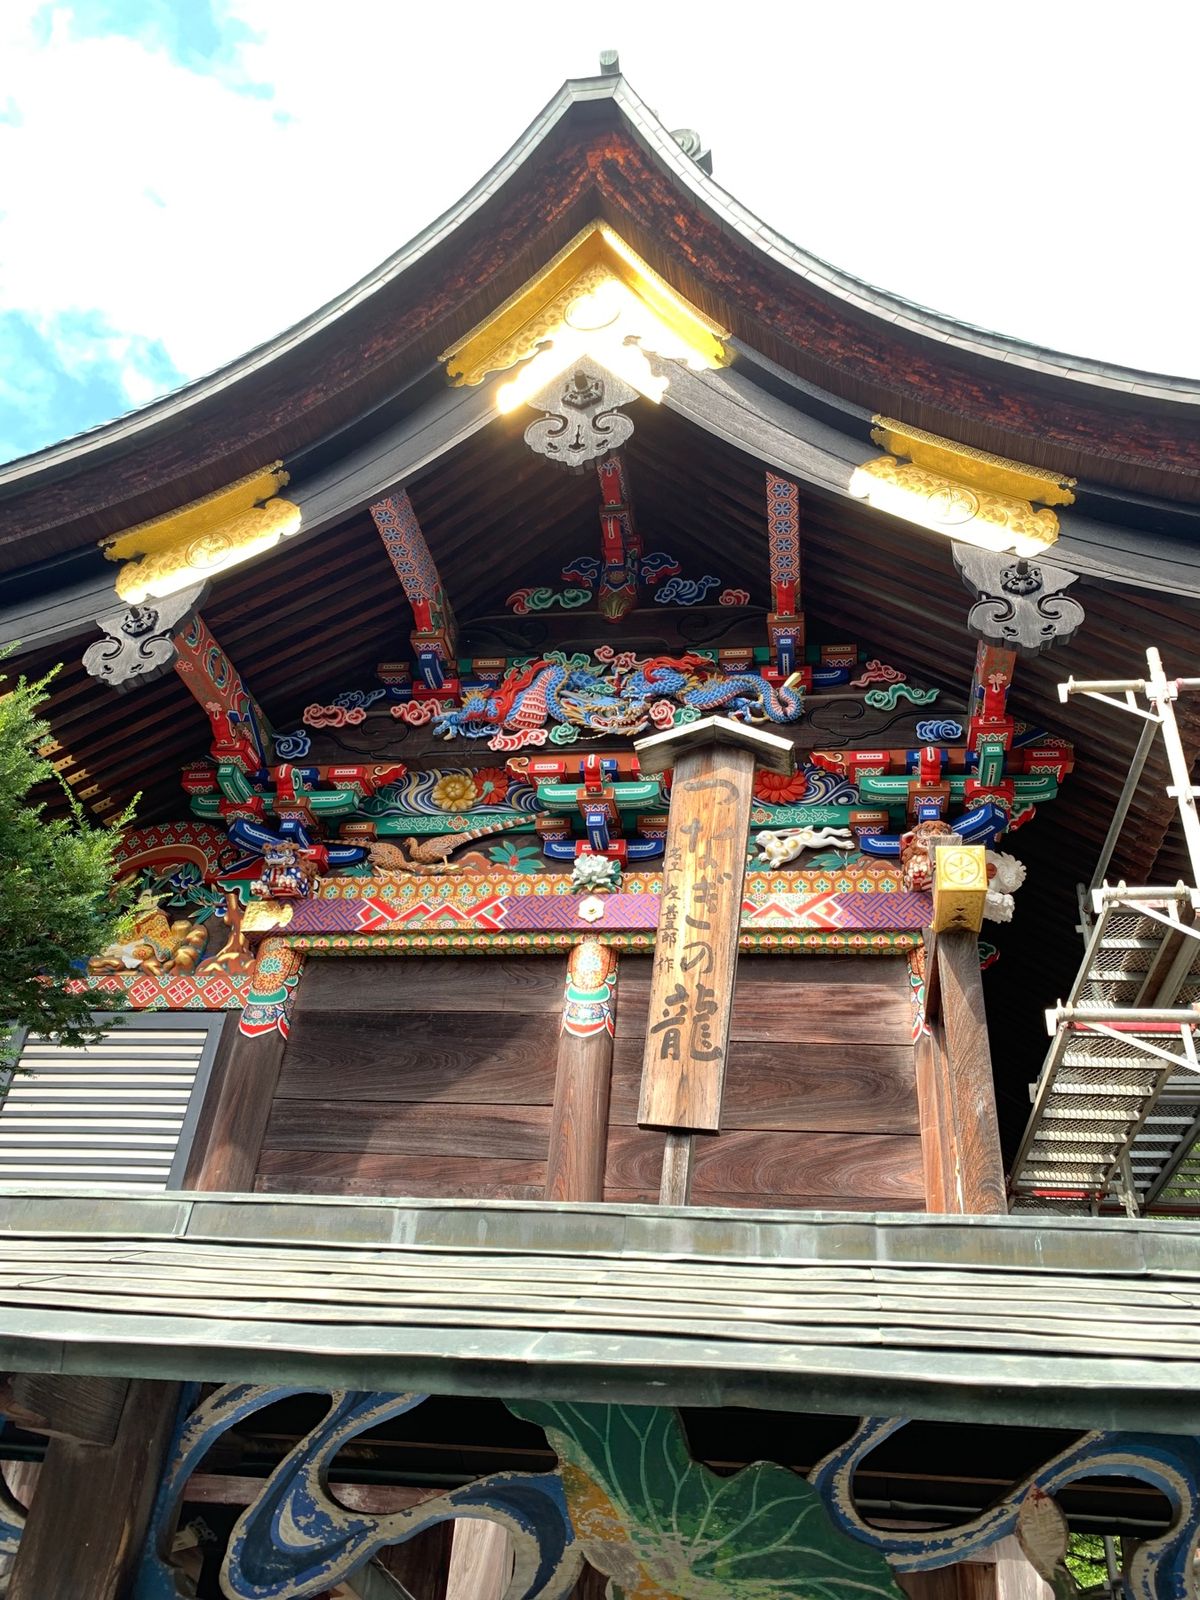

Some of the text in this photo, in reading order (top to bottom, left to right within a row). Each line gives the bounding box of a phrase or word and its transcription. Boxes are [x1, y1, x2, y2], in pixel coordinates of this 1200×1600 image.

[651, 778, 740, 1062] つなぎの龍
[656, 956, 675, 973] 作
